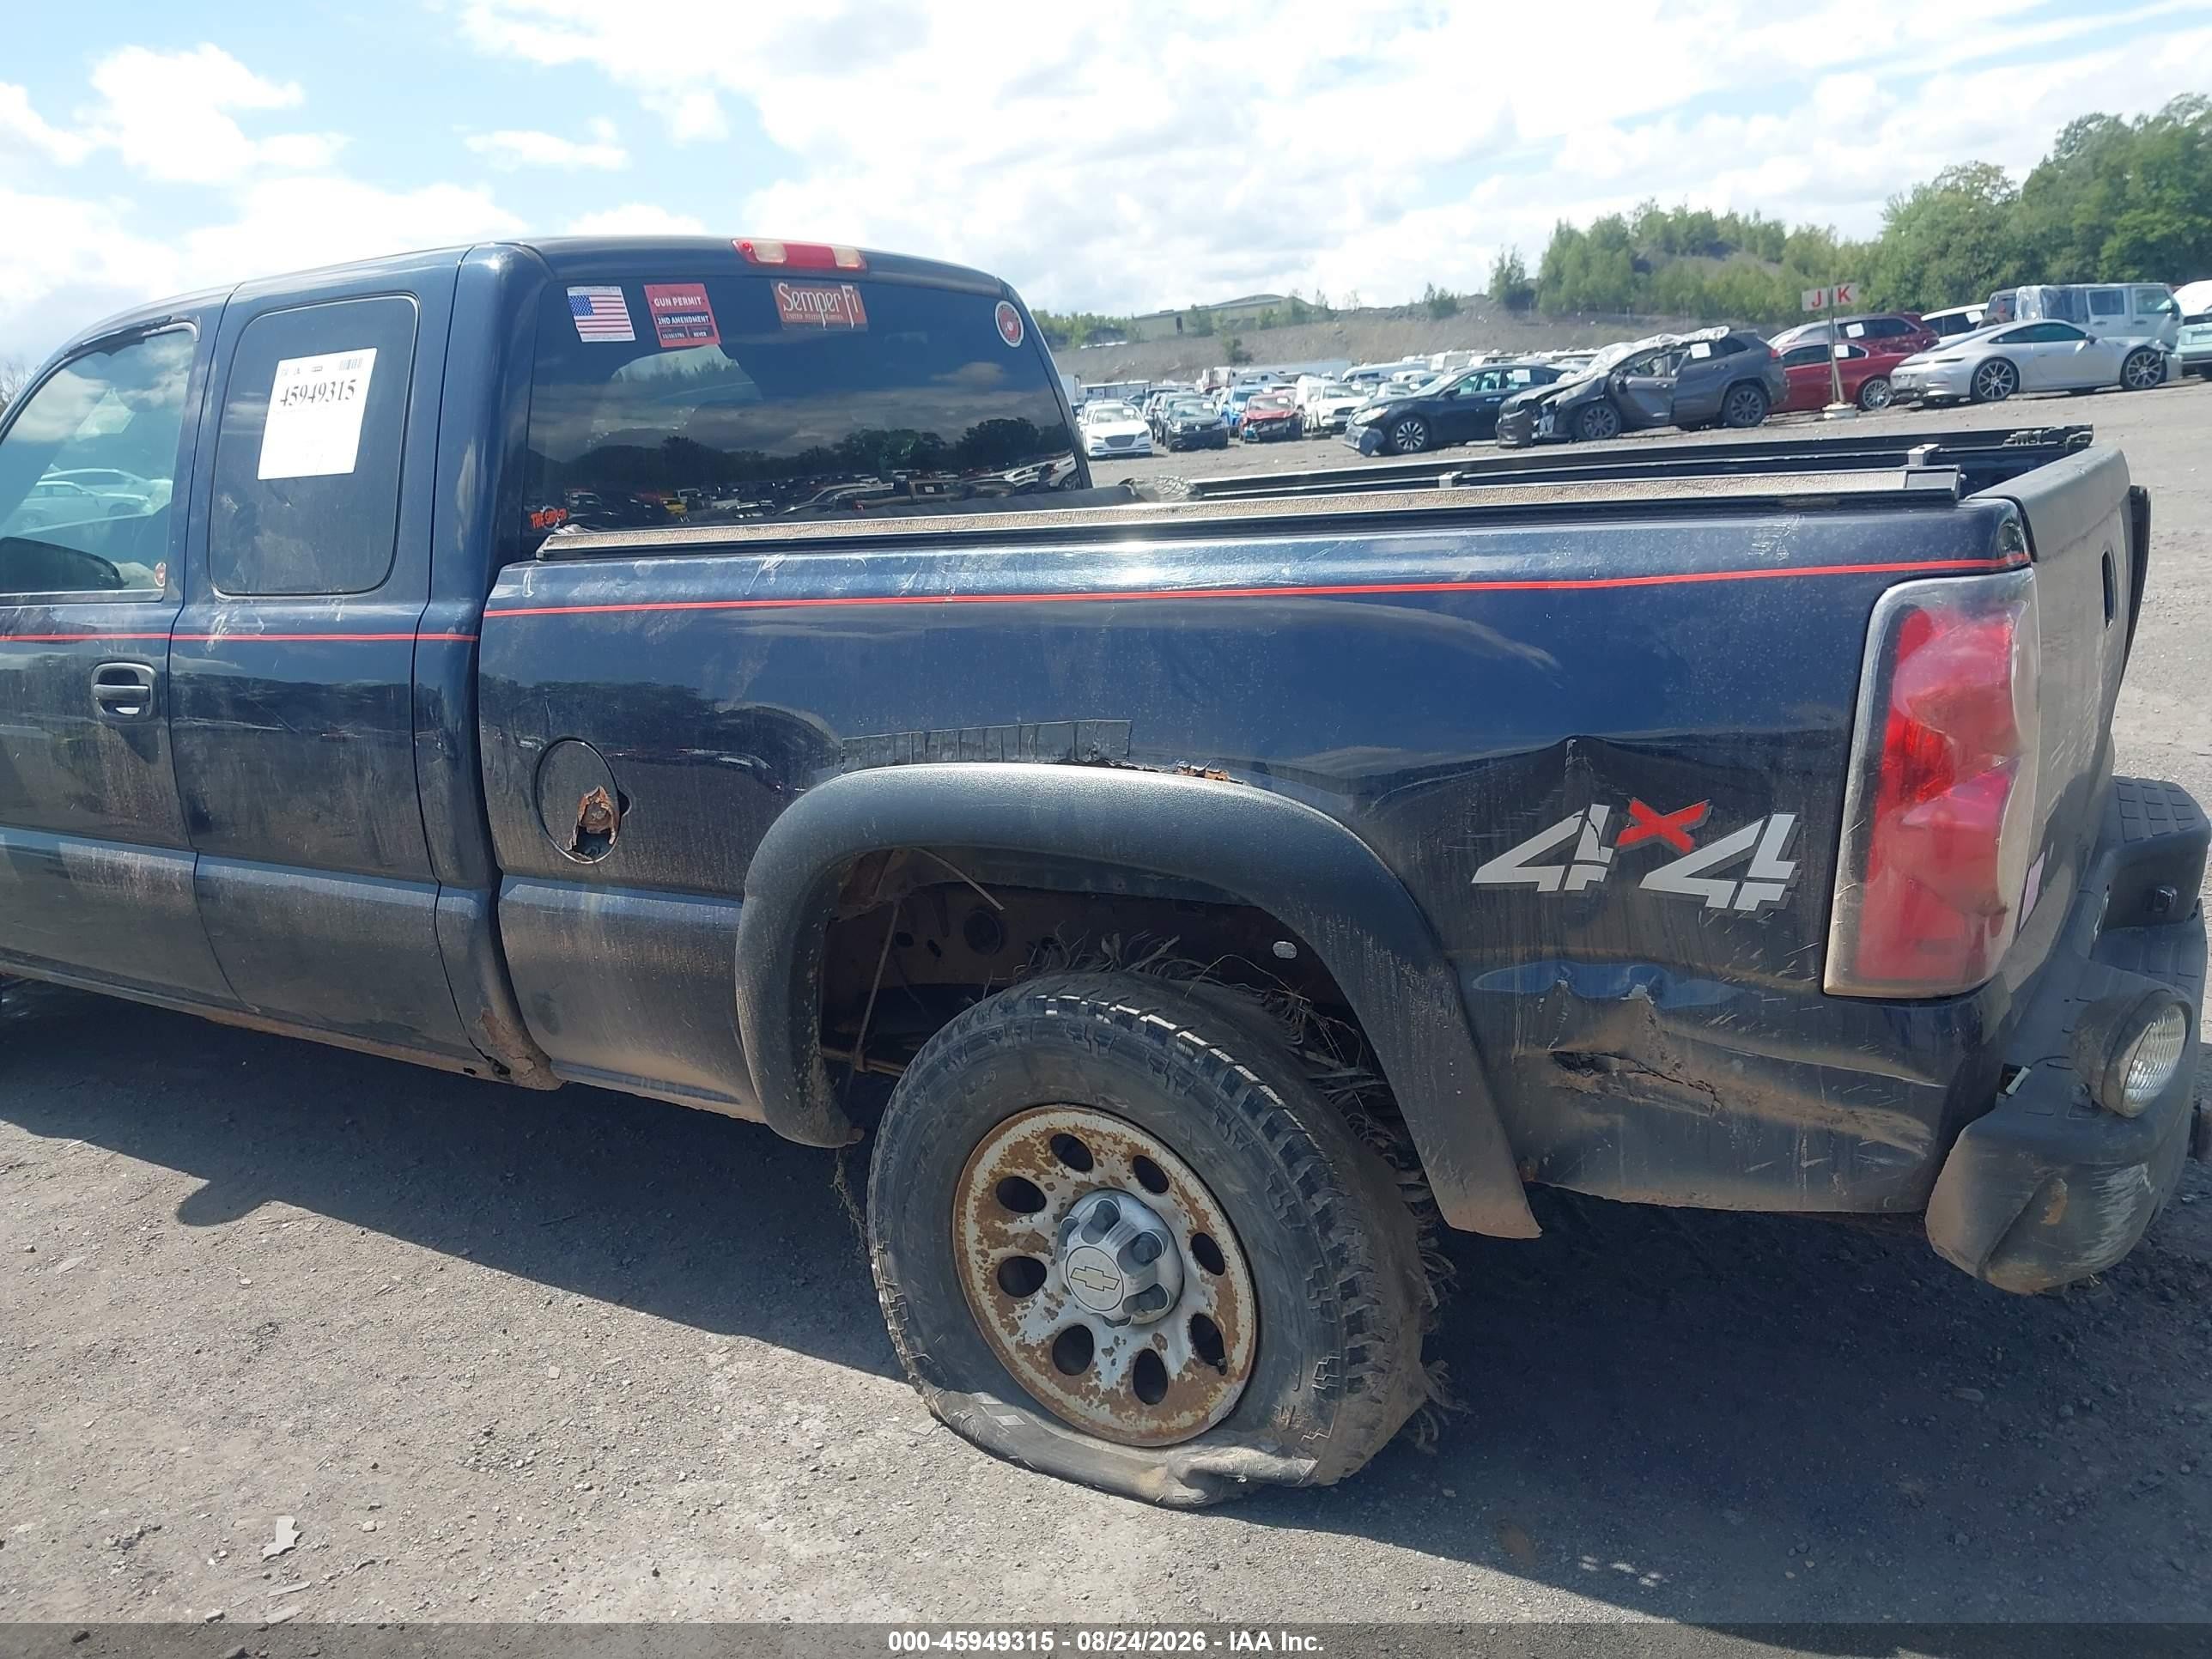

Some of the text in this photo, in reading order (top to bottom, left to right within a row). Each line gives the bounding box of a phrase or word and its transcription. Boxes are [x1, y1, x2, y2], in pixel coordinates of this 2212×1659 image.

[653, 295, 702, 307] GUN PERMIT
[1812, 290, 1821, 307] J
[1838, 285, 1851, 302] K
[778, 282, 859, 329] Semper Fi
[658, 314, 710, 325] 2ND AMENDMENT
[280, 376, 357, 406] 45949315
